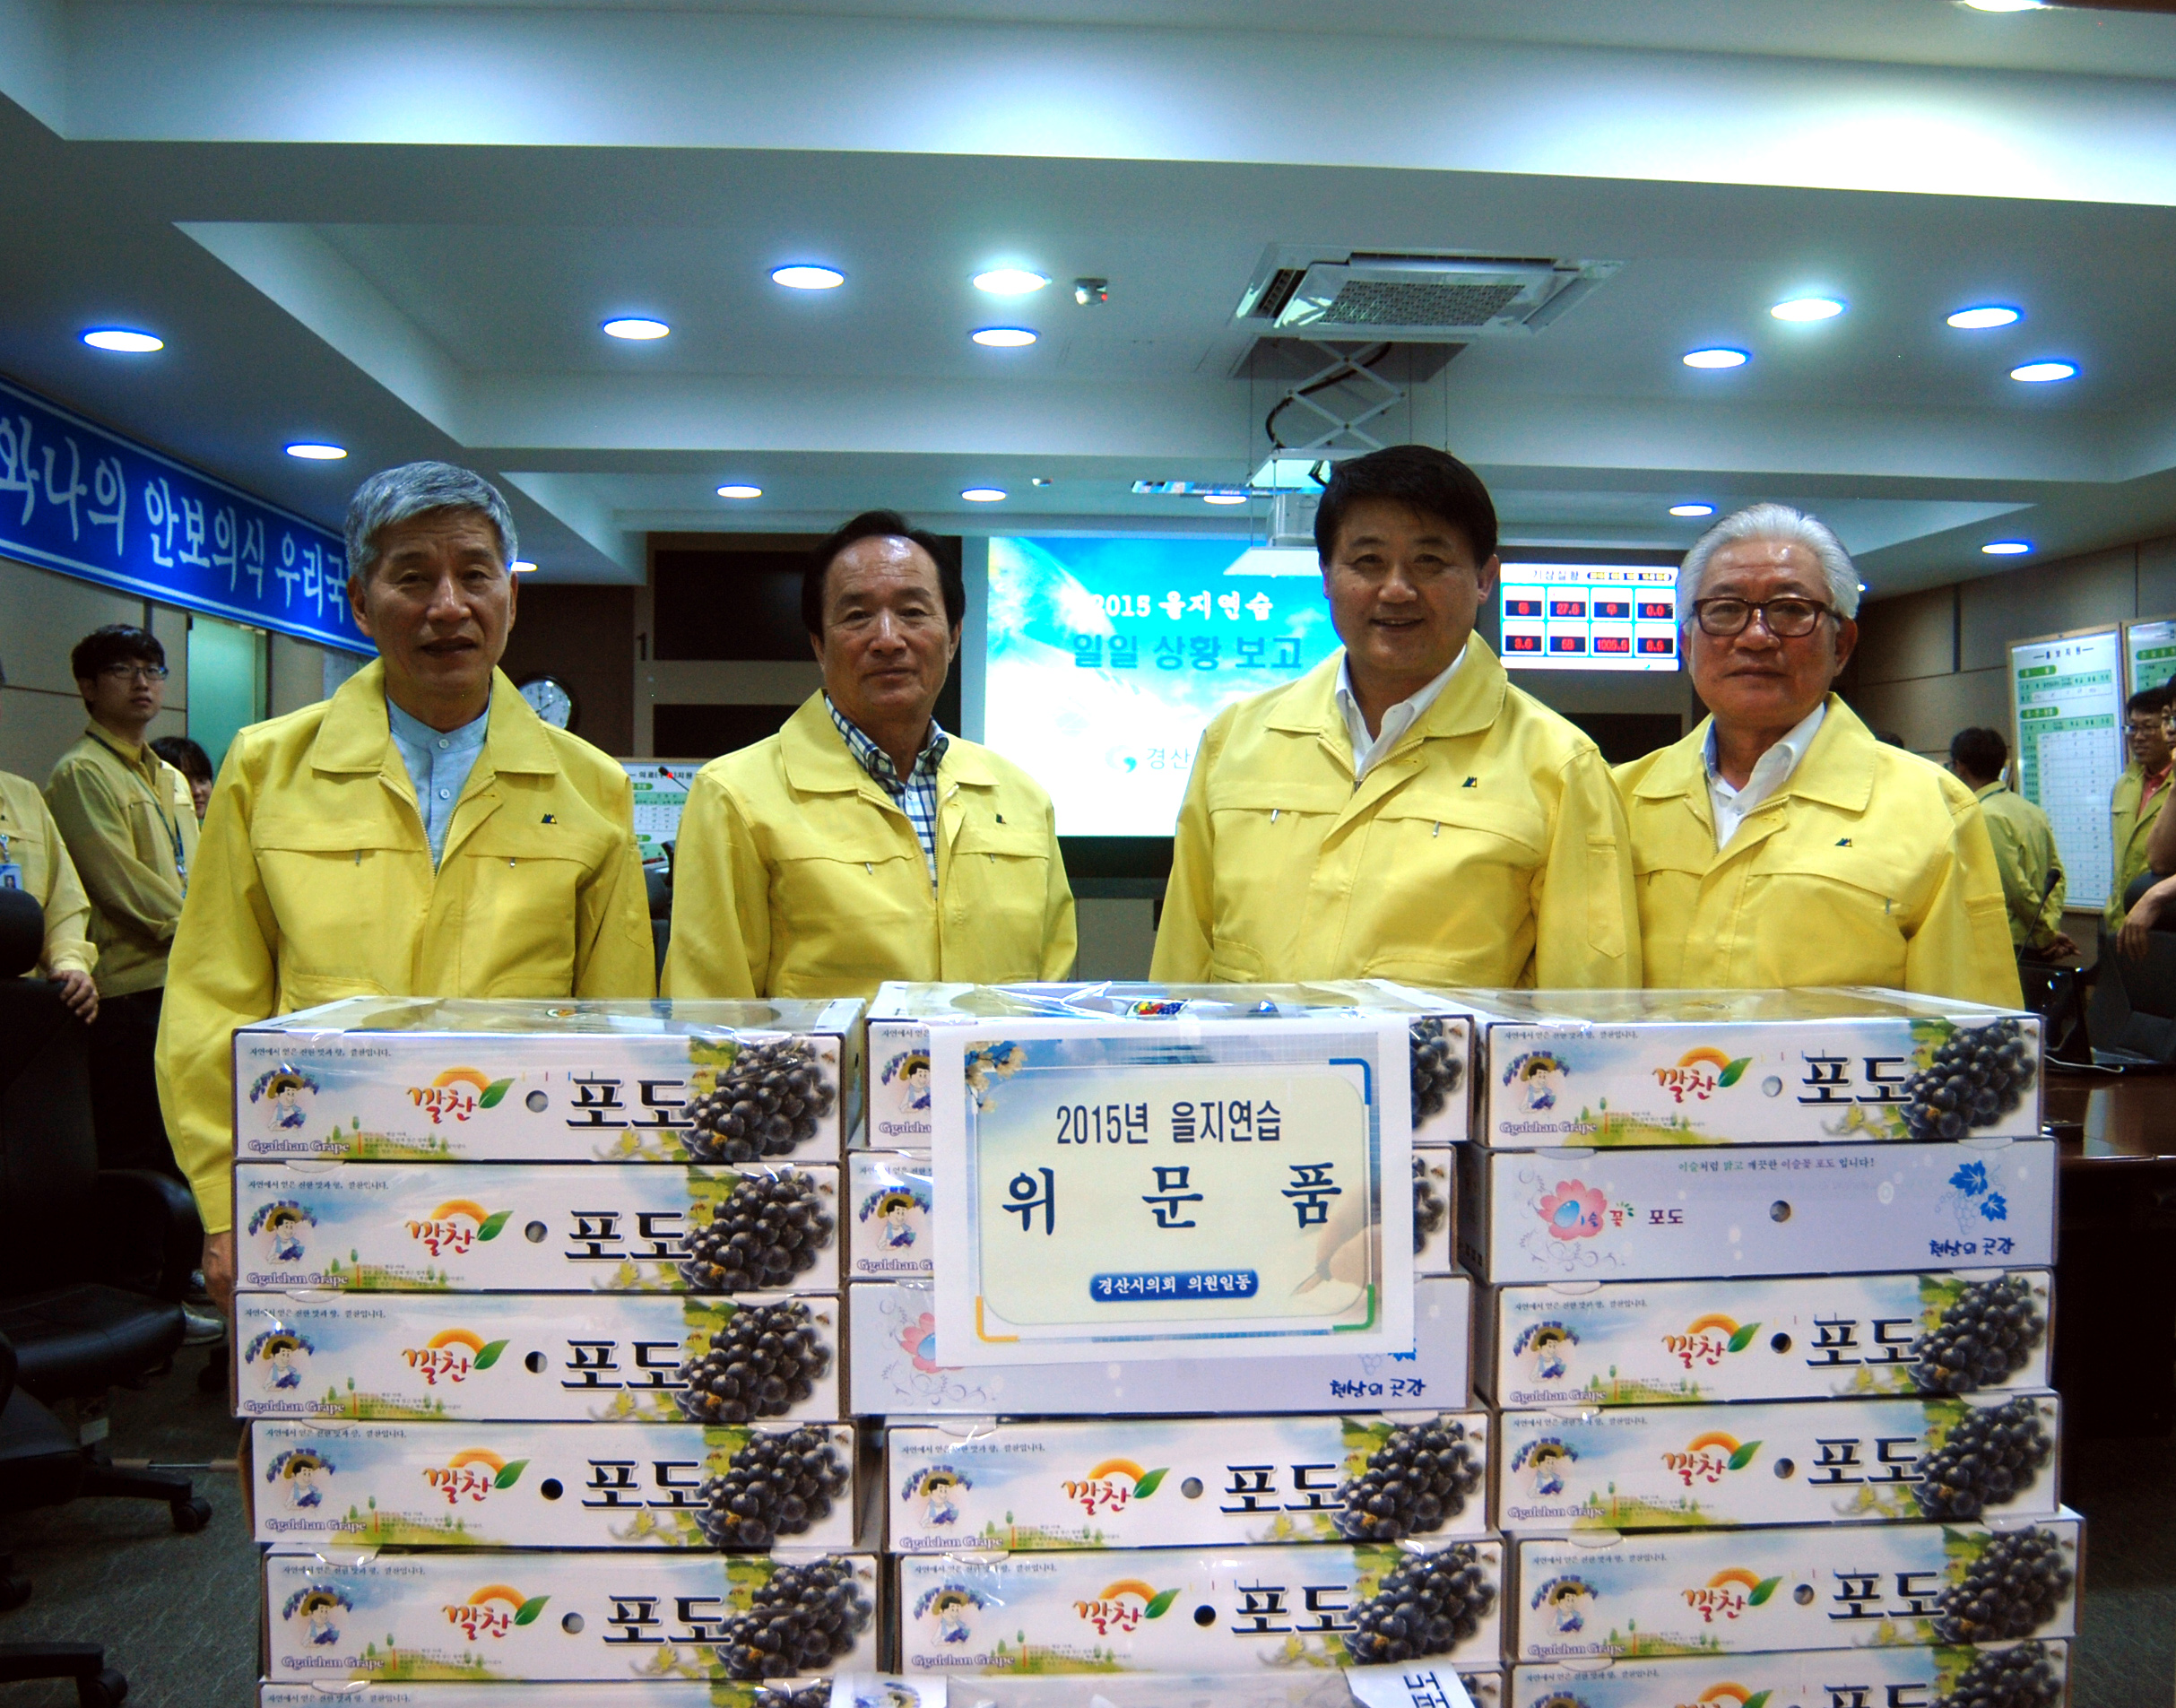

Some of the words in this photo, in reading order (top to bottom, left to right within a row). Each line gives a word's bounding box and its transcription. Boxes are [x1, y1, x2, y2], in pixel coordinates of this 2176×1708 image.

[144, 477, 264, 600] 안보의식
[1094, 594, 1150, 618] 2015
[1158, 591, 1273, 621] 을지연습
[1073, 634, 1137, 669] 일일
[1155, 635, 1221, 671] 상황
[1235, 636, 1302, 669] 보고
[1650, 1067, 1717, 1104] 깔찬
[1798, 1055, 1914, 1103] 포도
[406, 1088, 477, 1124] 깔찬
[567, 1079, 695, 1127] 포도
[879, 1121, 932, 1136] Ggalcha
[1056, 1102, 1149, 1144] 2015년
[1171, 1100, 1281, 1143] 을지연습
[1499, 1121, 1558, 1137] Ggalchan
[1559, 1120, 1597, 1136] Grape
[247, 1139, 308, 1154] Ggalchan
[310, 1140, 350, 1155] Grape
[565, 1210, 693, 1259] 포도
[1649, 1209, 1683, 1224] 포도
[404, 1220, 475, 1256] 깔찬
[247, 1272, 308, 1287] Ggalchan
[308, 1272, 349, 1288] Grape
[856, 1258, 919, 1273] Ggalchan
[1097, 1276, 1176, 1295] 경산시의회
[1187, 1273, 1252, 1294] 의원일동
[1660, 1333, 1726, 1370] 깔찬
[1806, 1316, 1922, 1366] 포도
[401, 1348, 472, 1385] 깔찬
[561, 1340, 689, 1388] 포도
[243, 1400, 304, 1415] Ggalchan
[306, 1400, 345, 1415] Grape
[1510, 1389, 1568, 1406] Ggalchan
[1569, 1387, 1607, 1403] Grape
[1659, 1451, 1727, 1487] 깔찬
[1808, 1435, 1927, 1485] 포도
[422, 1468, 493, 1504] 깔찬
[582, 1459, 709, 1507] 포도
[1060, 1478, 1131, 1516] 깔찬
[1220, 1461, 1347, 1513] 포도
[265, 1518, 325, 1533] Ggalchan
[327, 1519, 367, 1534] Grape
[1508, 1505, 1566, 1522] Ggalchan
[1567, 1504, 1606, 1520] Grape
[899, 1535, 962, 1552] Ggalchan
[963, 1534, 1003, 1550] Grape
[1231, 1583, 1358, 1634] 포도
[1679, 1587, 1747, 1624] 깔찬
[1828, 1570, 1947, 1619] 포도
[441, 1605, 513, 1641] 깔찬
[603, 1595, 732, 1643] 포도
[1071, 1599, 1143, 1635] 깔찬
[282, 1656, 342, 1670] Ggalchan
[344, 1656, 385, 1671] Grape
[911, 1653, 974, 1670] Ggalchan
[975, 1652, 1015, 1669] Grape
[1528, 1643, 1586, 1659] Ggalchan
[1587, 1641, 1625, 1657] Grape
